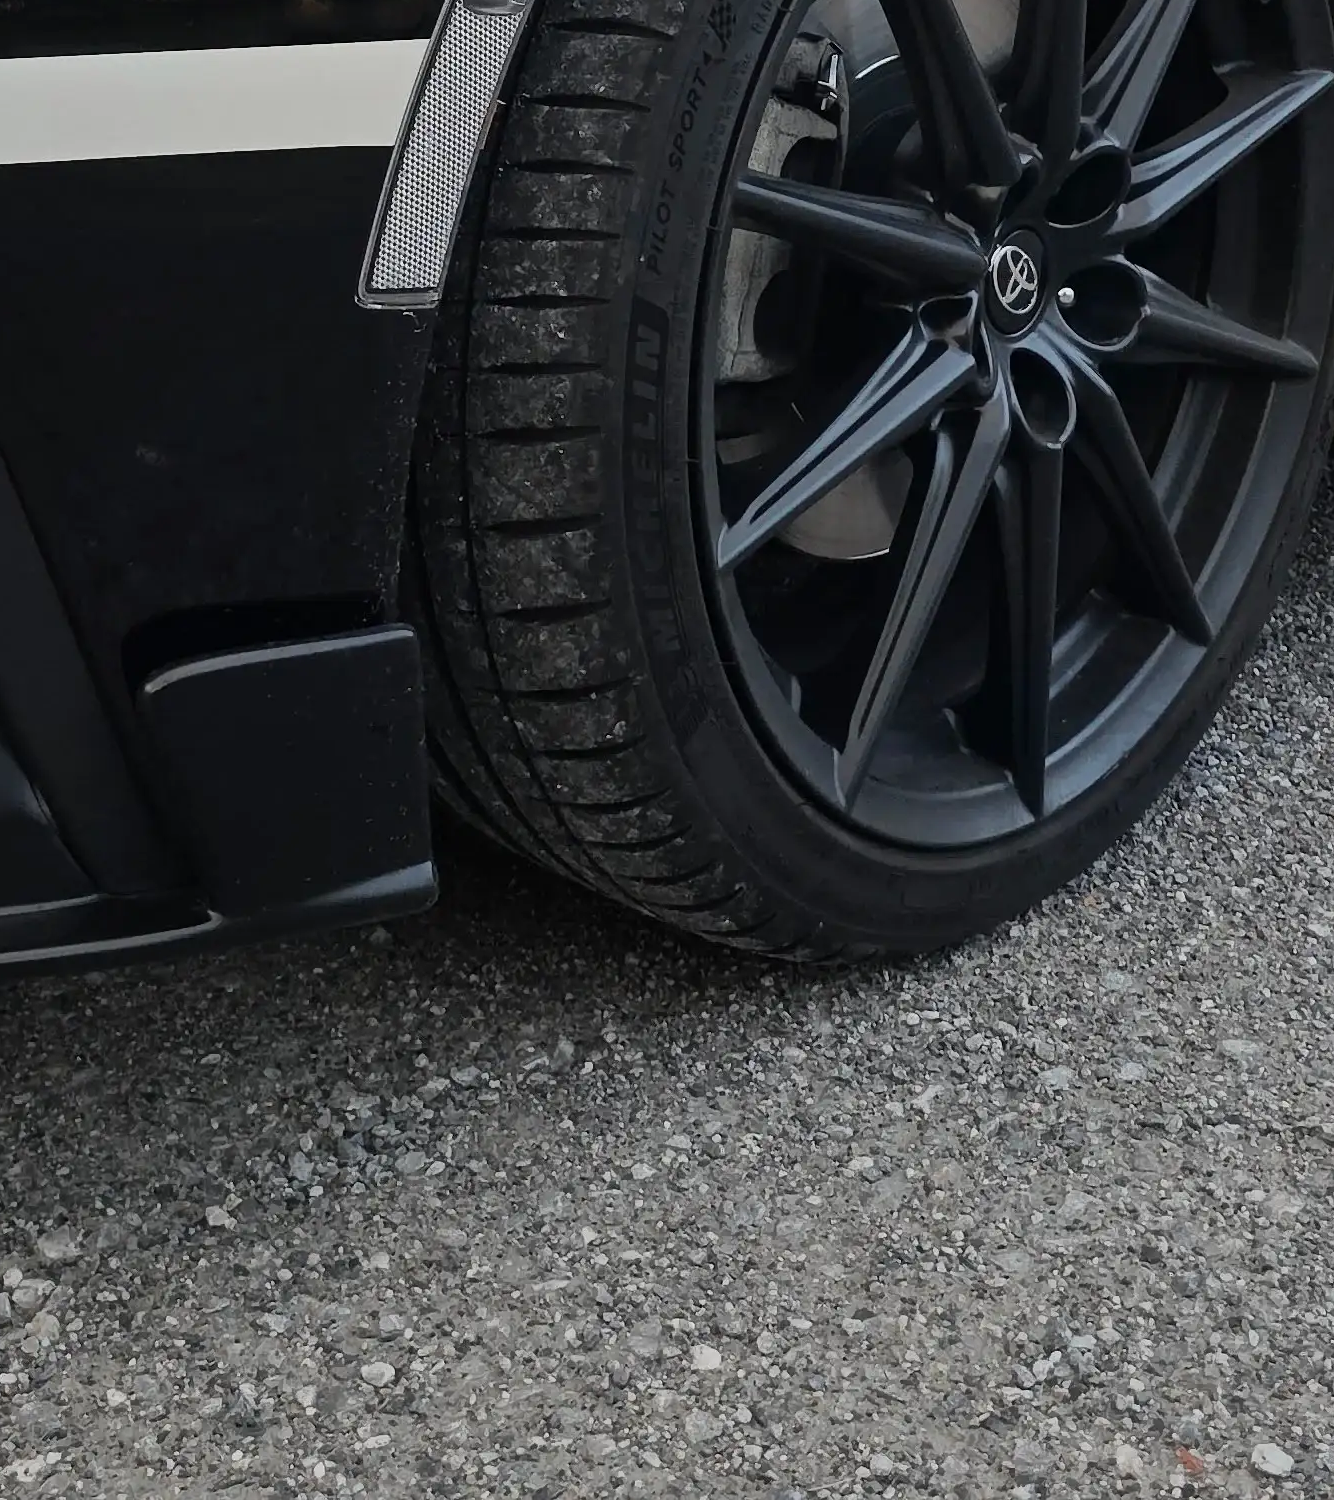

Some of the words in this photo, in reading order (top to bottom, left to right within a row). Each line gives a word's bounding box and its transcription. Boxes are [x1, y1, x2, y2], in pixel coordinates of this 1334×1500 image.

[644, 177, 675, 276] PILOT
[666, 65, 708, 172] SPORT
[633, 326, 680, 652] MICHELIN
